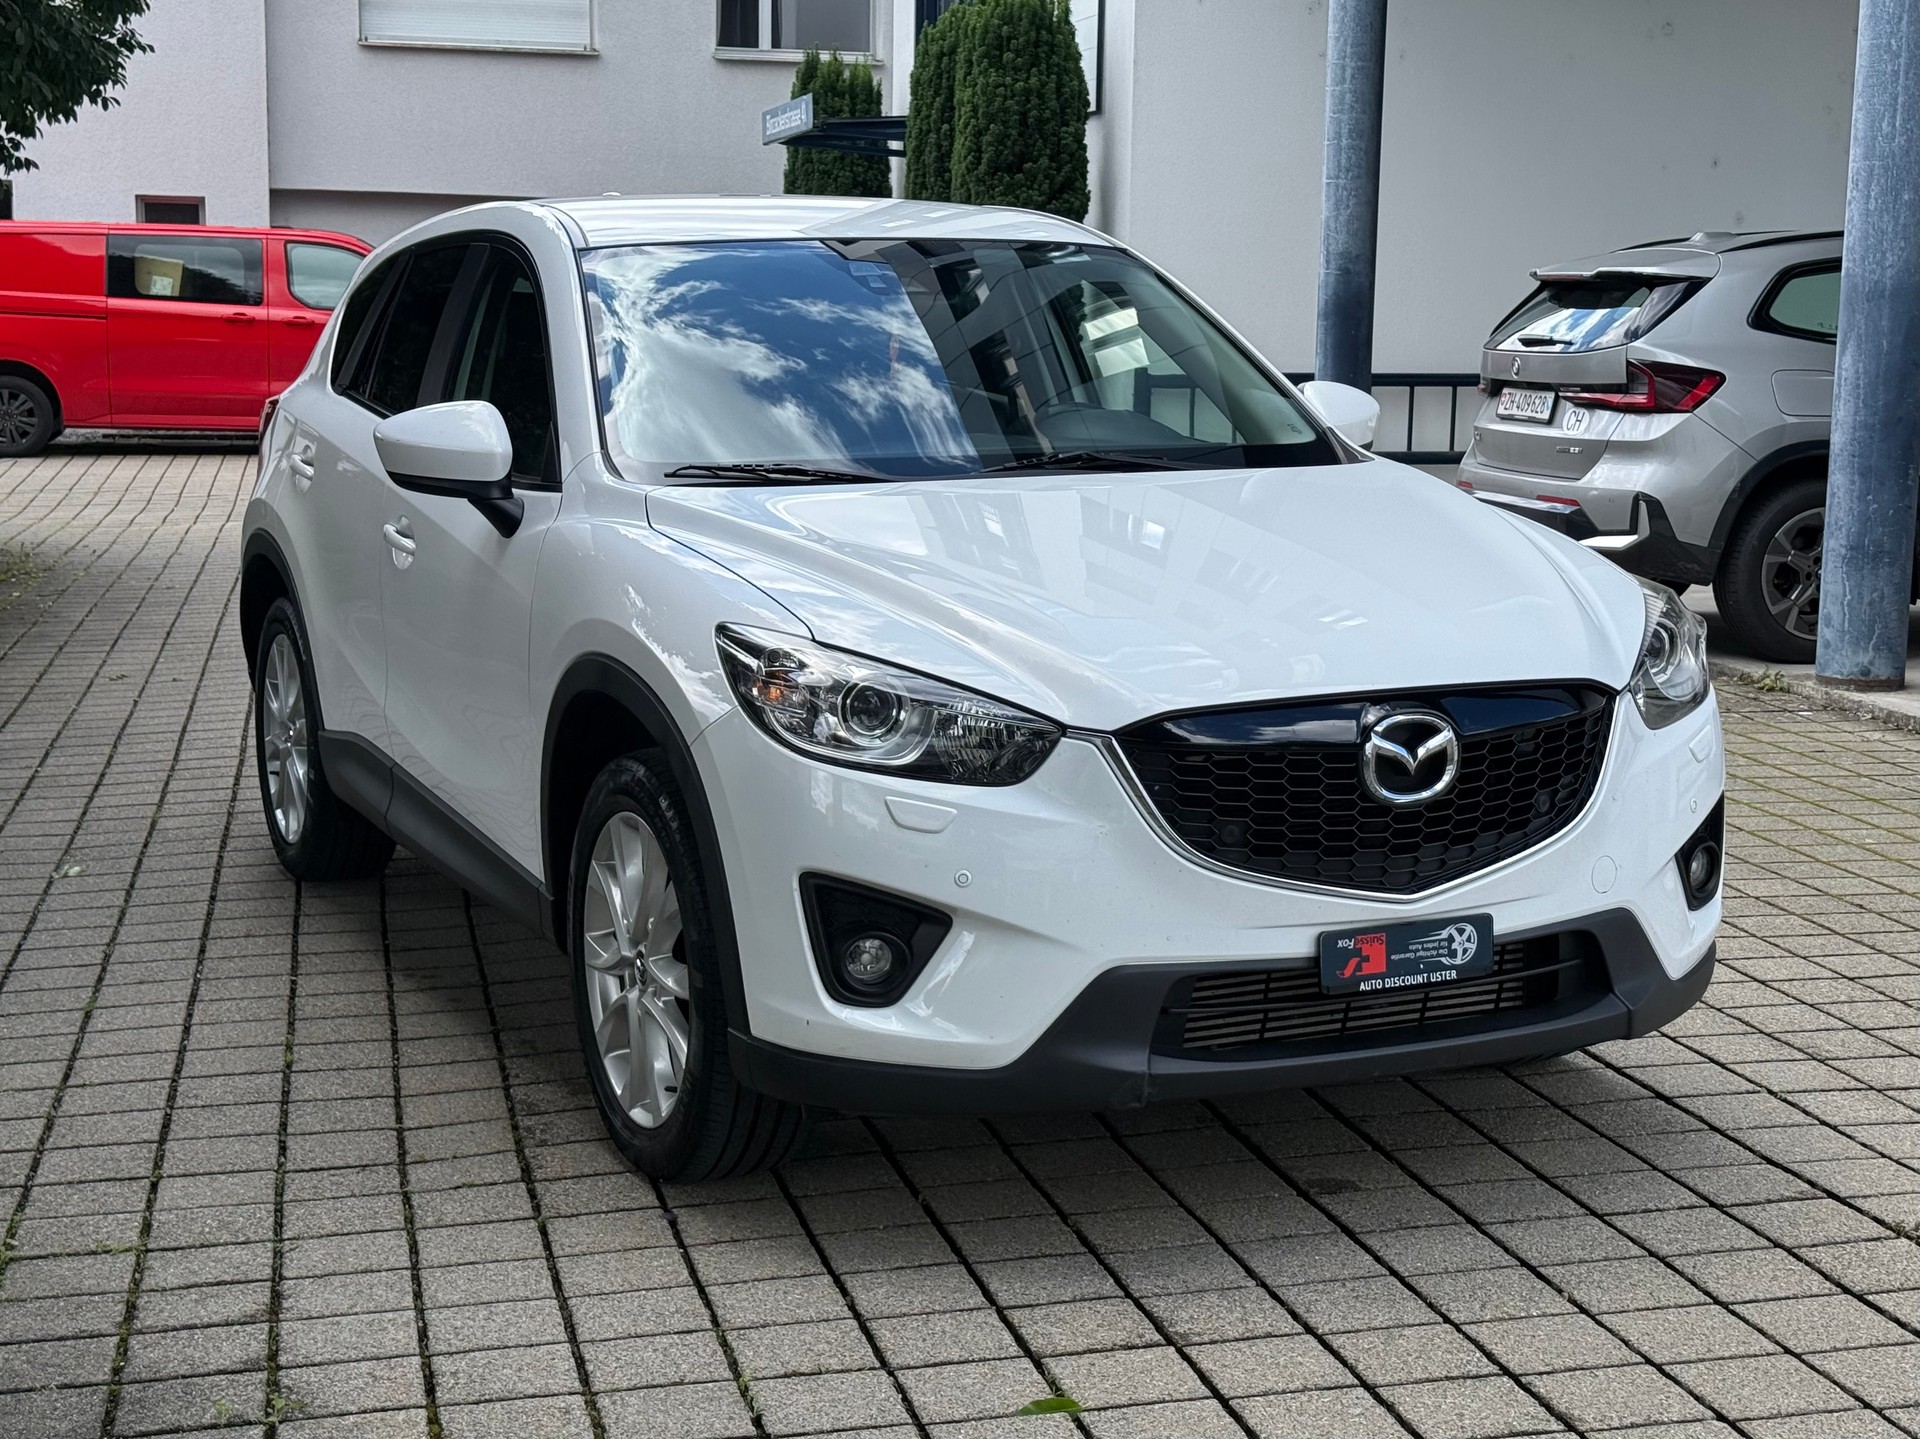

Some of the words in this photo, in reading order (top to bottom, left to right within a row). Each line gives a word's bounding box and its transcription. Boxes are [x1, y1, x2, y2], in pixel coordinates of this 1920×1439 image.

[1566, 410, 1585, 431] CH
[1359, 979, 1383, 991] AUTO
[1385, 975, 1428, 988] DISCOUNT
[1430, 970, 1457, 981] USTER
